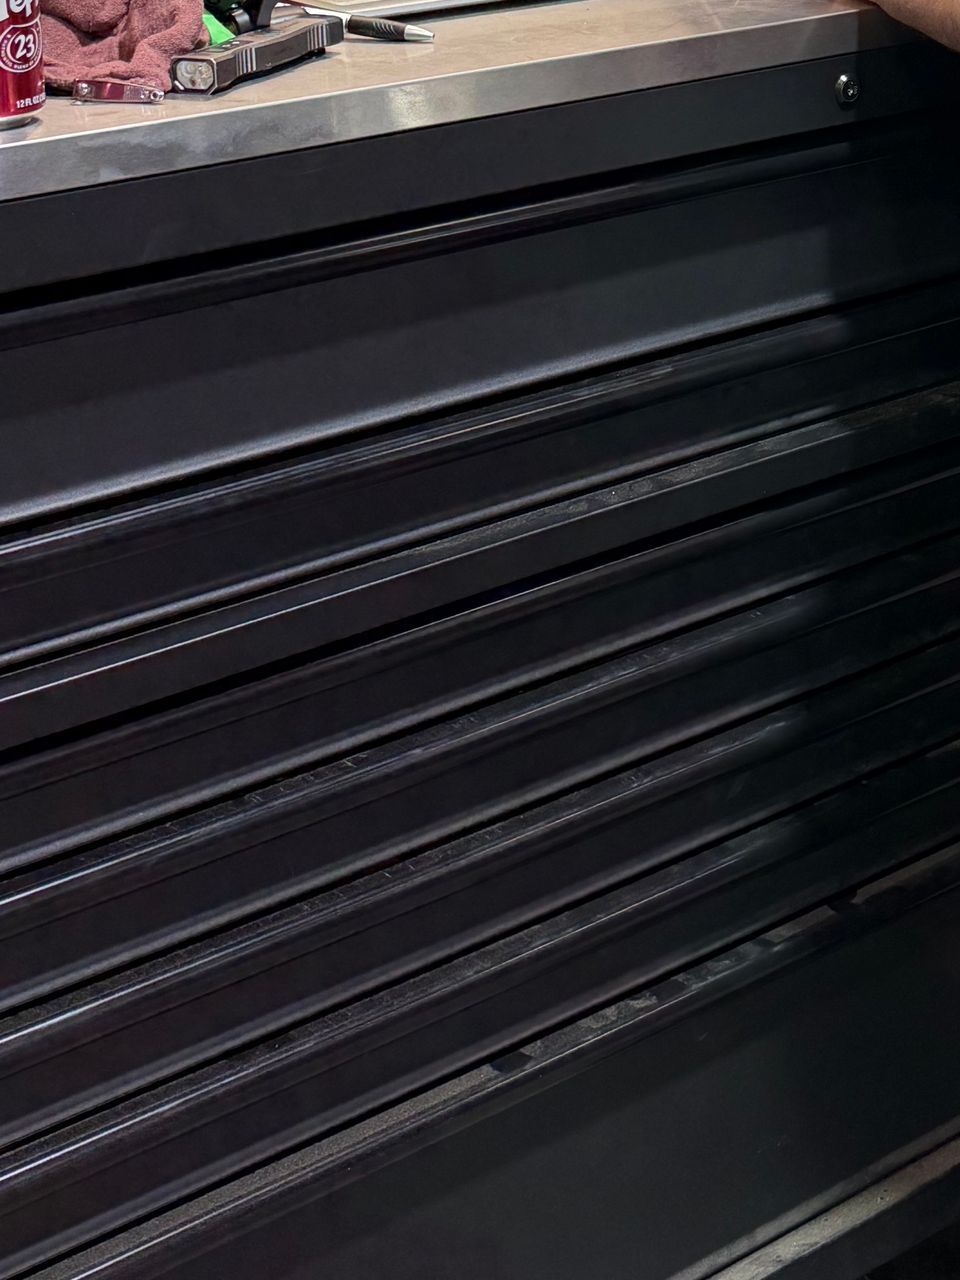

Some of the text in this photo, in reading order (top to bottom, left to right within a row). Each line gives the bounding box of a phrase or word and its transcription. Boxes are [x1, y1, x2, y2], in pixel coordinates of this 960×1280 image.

[14, 34, 35, 60] 23
[16, 99, 25, 109] 12
[25, 97, 33, 107] FL
